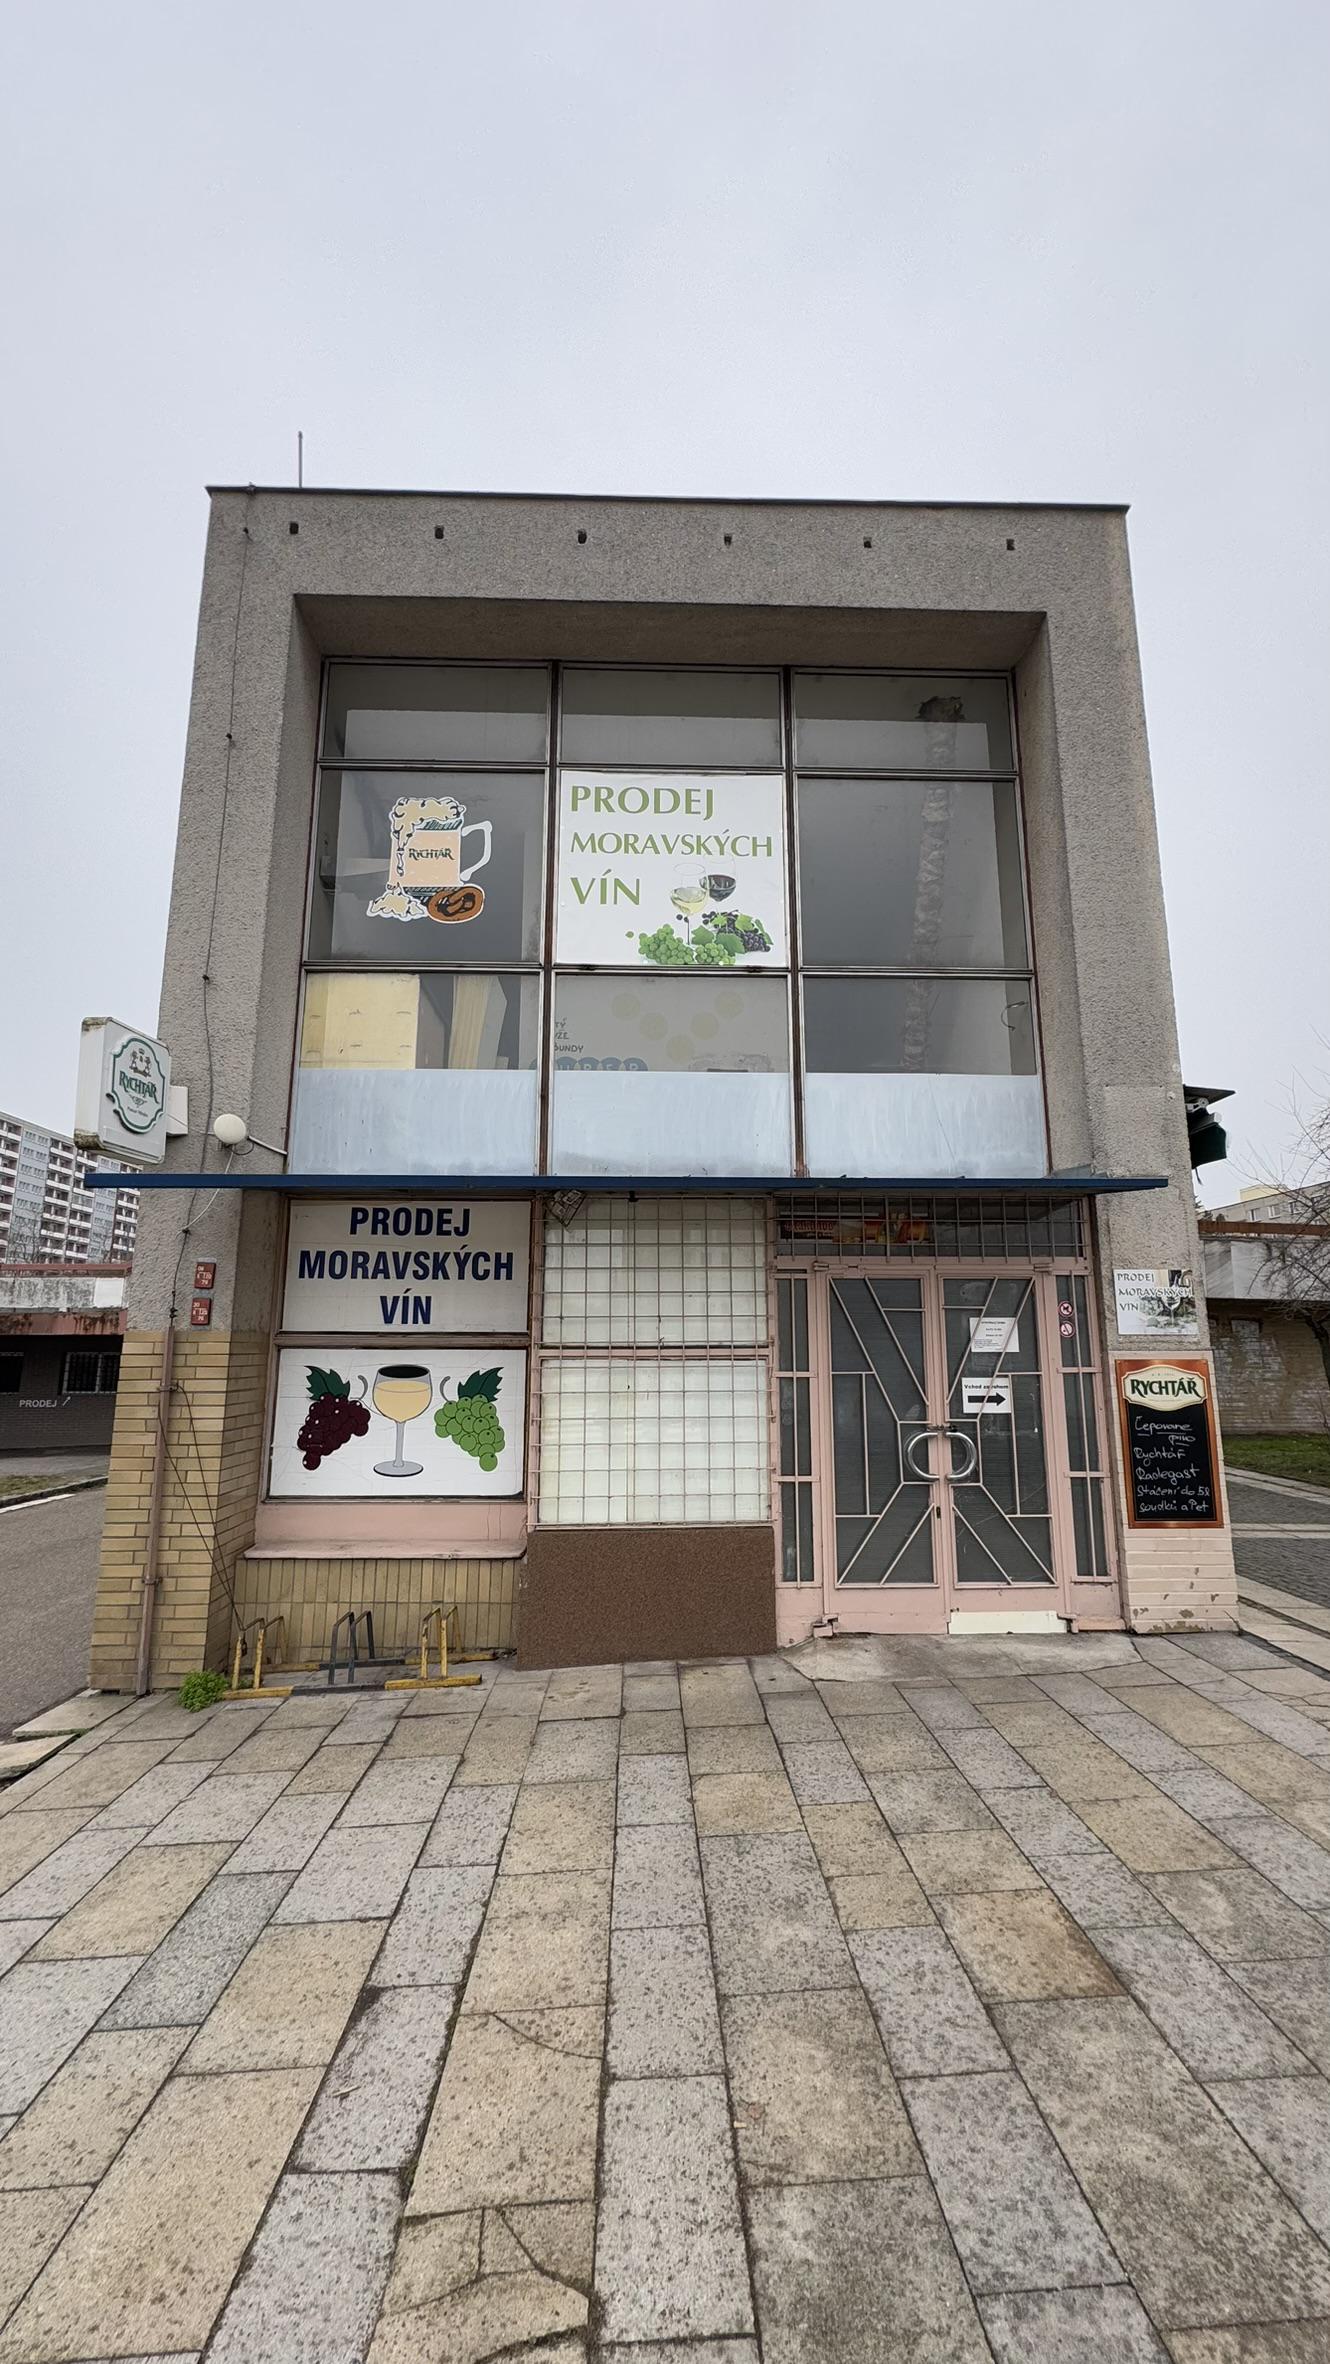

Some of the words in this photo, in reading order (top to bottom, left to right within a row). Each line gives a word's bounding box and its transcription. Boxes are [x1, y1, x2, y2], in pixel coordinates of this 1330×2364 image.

[570, 785, 714, 821] PRODEJ
[570, 829, 773, 857] MORAVSKÝCH
[570, 868, 640, 906] VÍN
[349, 1207, 471, 1236] PRODEJ
[298, 1244, 514, 1281] MORAVSKÝCH
[1117, 1272, 1155, 1283] PRODEJ
[379, 1288, 433, 1325] VÍN
[1130, 1377, 1203, 1399] RYCHTÁŘ
[19, 1399, 58, 1408] PRODEJ
[1135, 1463, 1201, 1486] Radegast
[1180, 1485, 1196, 1496] do
[1188, 1498, 1209, 1513] Pet
